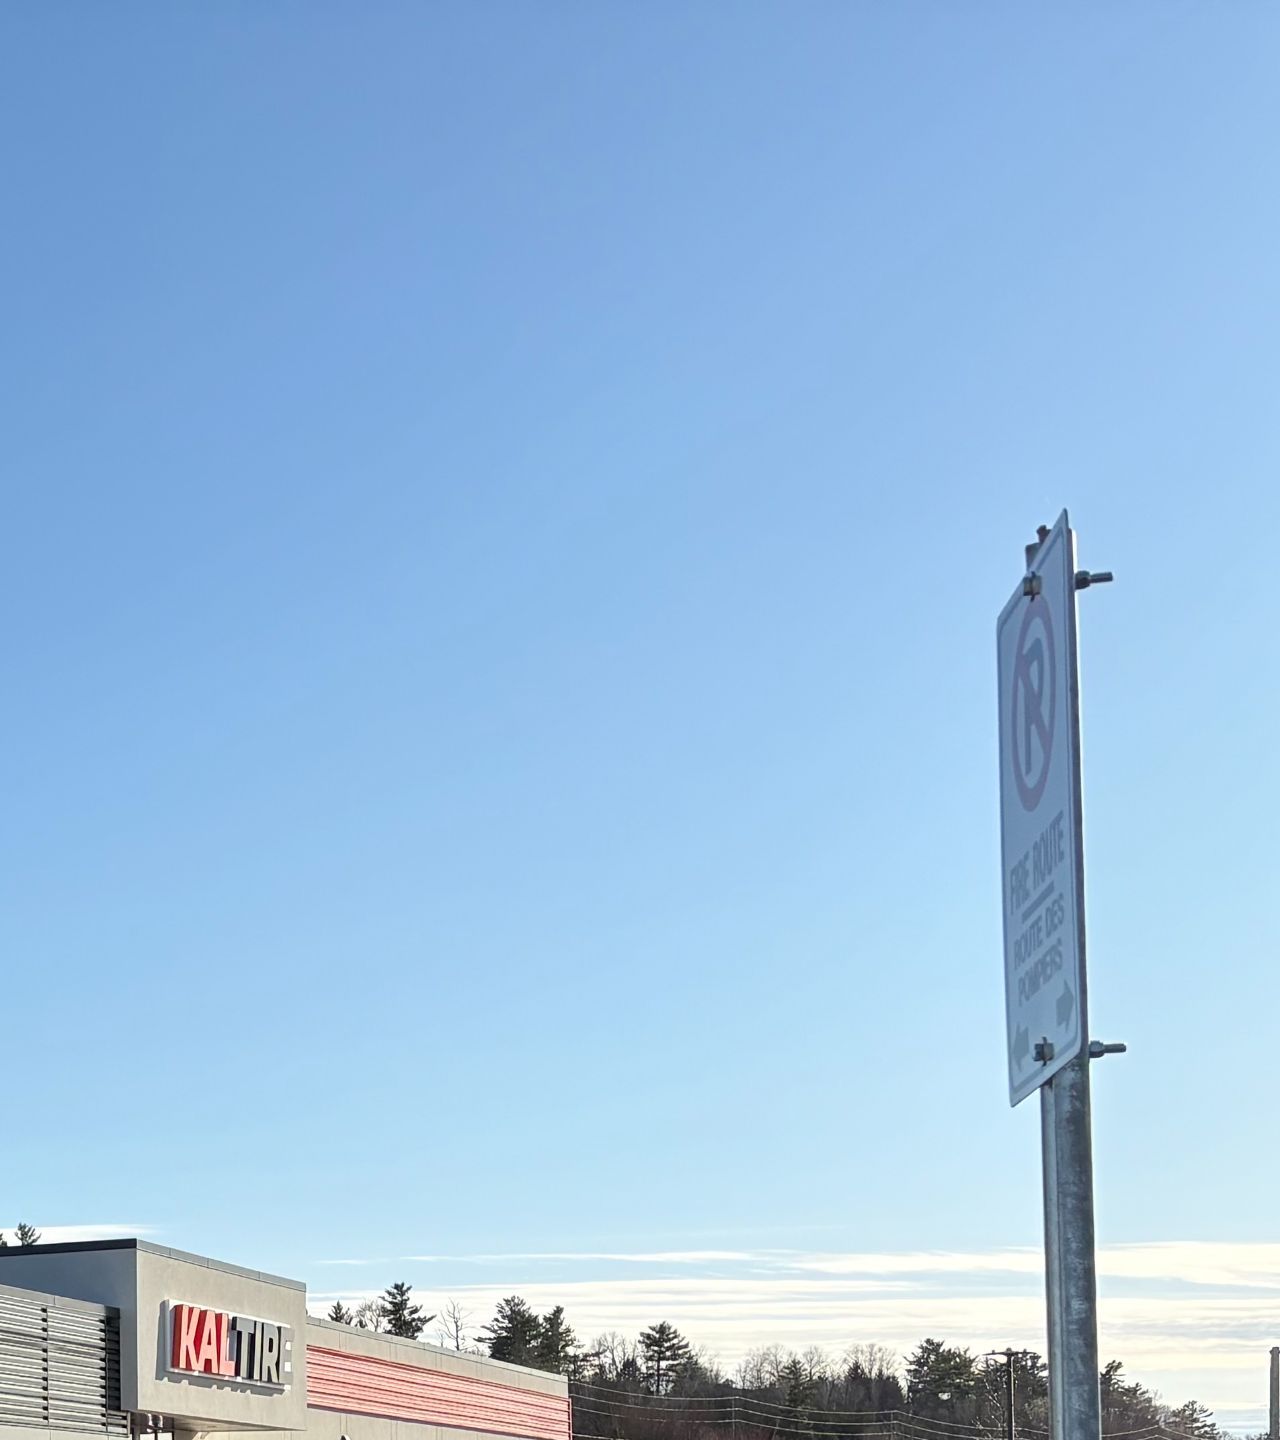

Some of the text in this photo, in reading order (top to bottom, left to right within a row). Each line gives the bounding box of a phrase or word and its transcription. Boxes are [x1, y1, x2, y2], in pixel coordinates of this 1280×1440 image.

[1010, 810, 1065, 916] FIRE ROUTE
[1014, 892, 1065, 971] ROUTE DES
[1018, 937, 1063, 1008] POMPIERS
[173, 1303, 295, 1386] KAL TIRE
